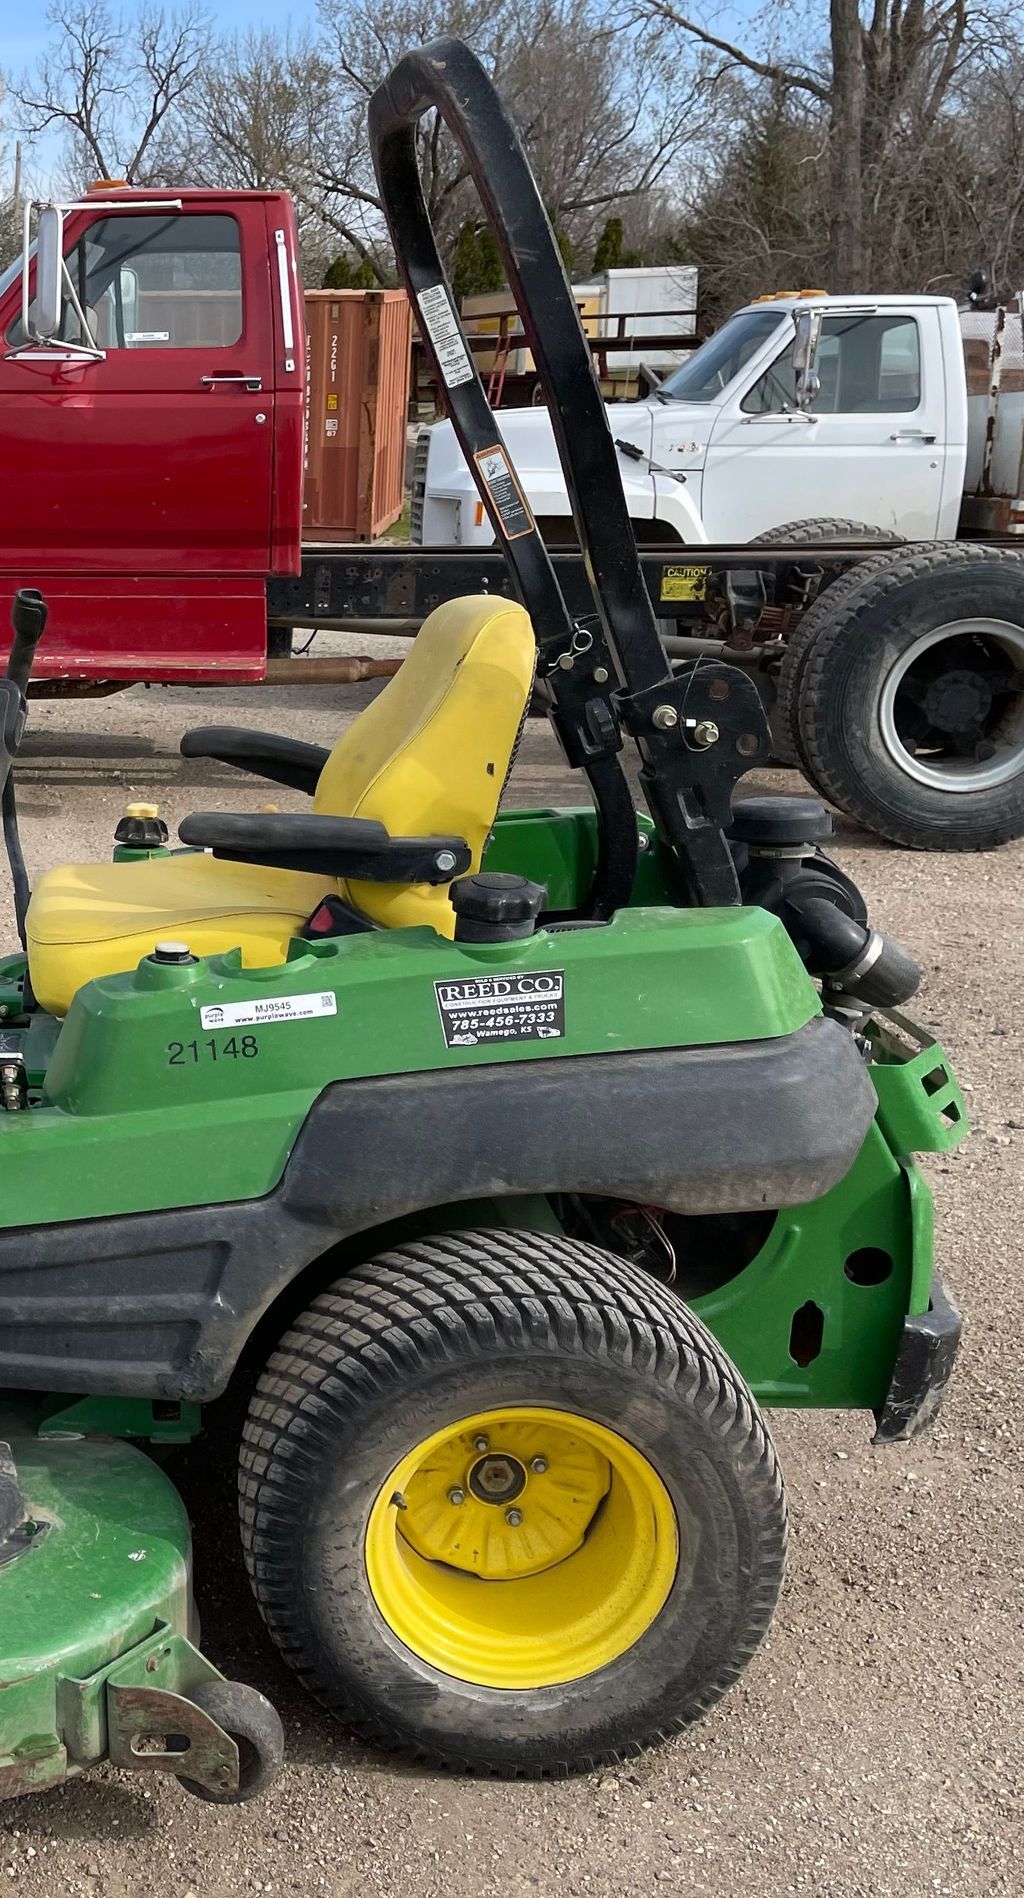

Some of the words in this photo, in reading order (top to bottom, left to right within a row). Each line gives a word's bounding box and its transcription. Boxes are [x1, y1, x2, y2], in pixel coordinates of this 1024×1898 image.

[667, 568, 707, 577] CAUTION
[445, 982, 511, 1001] REED
[517, 977, 560, 993] CO.
[255, 1002, 291, 1014] MJ9545
[448, 1003, 558, 1019] www.reedsales.com
[234, 1009, 313, 1023] www.purplewave.com
[451, 1012, 555, 1031] 785-456-7333
[520, 1026, 533, 1034] KS
[167, 1035, 259, 1065] 21148
